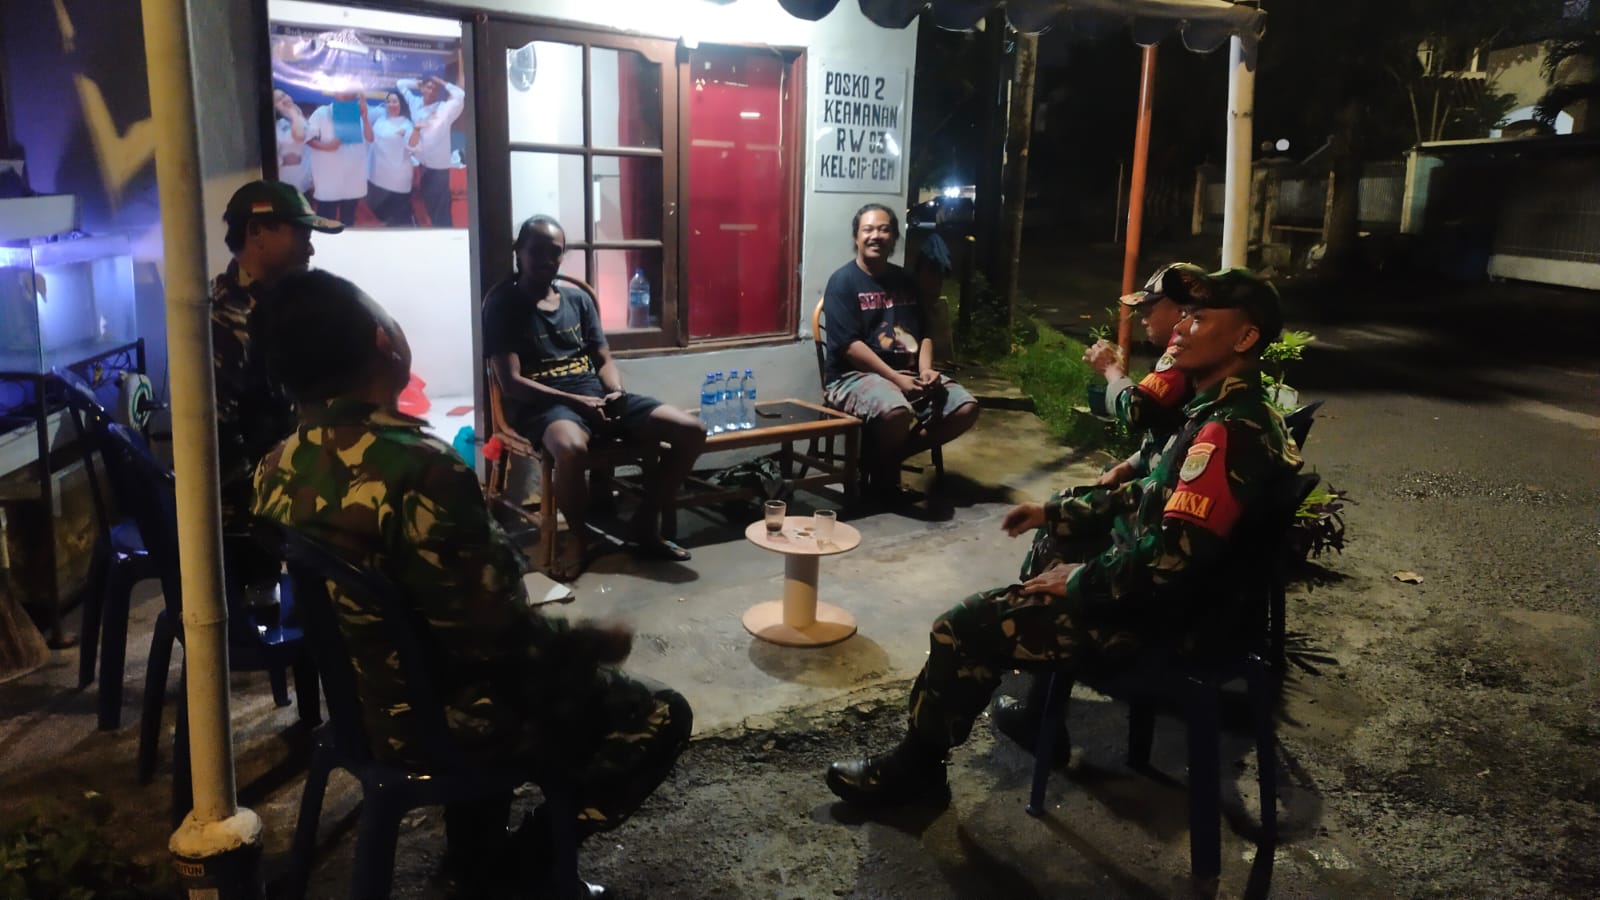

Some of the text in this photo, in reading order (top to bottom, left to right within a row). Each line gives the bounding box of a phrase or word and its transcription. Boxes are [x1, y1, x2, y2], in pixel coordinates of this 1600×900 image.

[825, 71, 886, 100] POSKO 2
[824, 99, 898, 128] KEAMANAN
